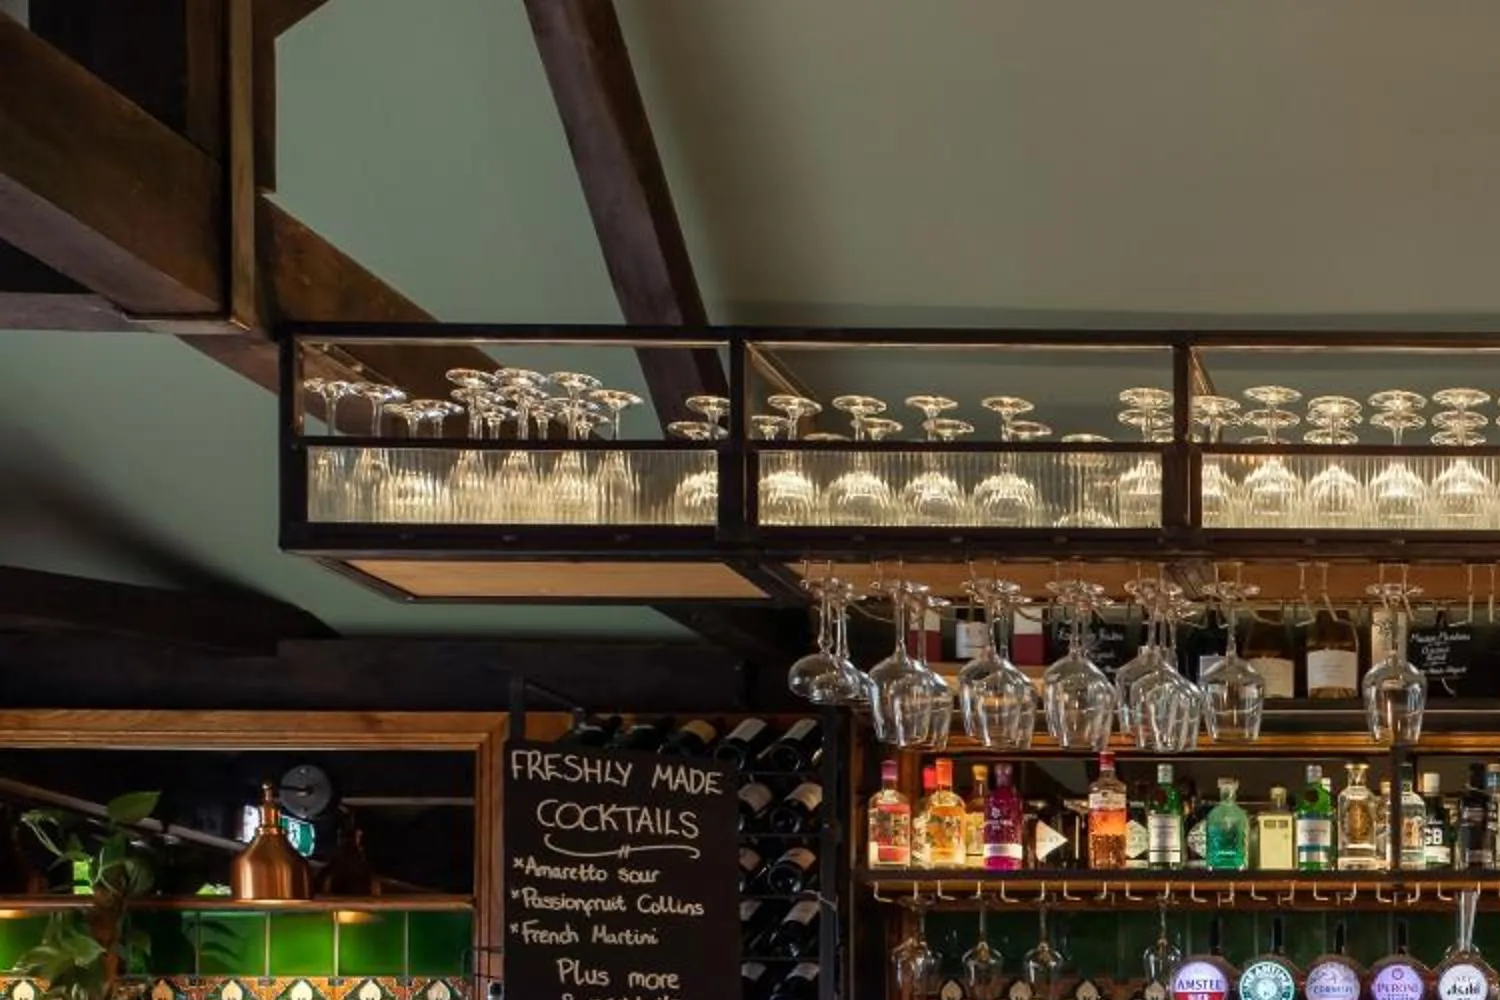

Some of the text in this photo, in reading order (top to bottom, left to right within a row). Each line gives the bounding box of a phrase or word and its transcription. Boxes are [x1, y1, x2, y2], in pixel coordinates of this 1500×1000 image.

[511, 750, 723, 795] FRESHLY MADE
[537, 799, 699, 839] COCKTAILS
[525, 856, 660, 884] Amaretto sour
[521, 887, 704, 917] Passionfruit Collins
[521, 920, 659, 945] French Martini
[556, 957, 680, 989] Plus more
[1177, 979, 1222, 991] AMSTEL
[1376, 982, 1419, 994] PERONI
